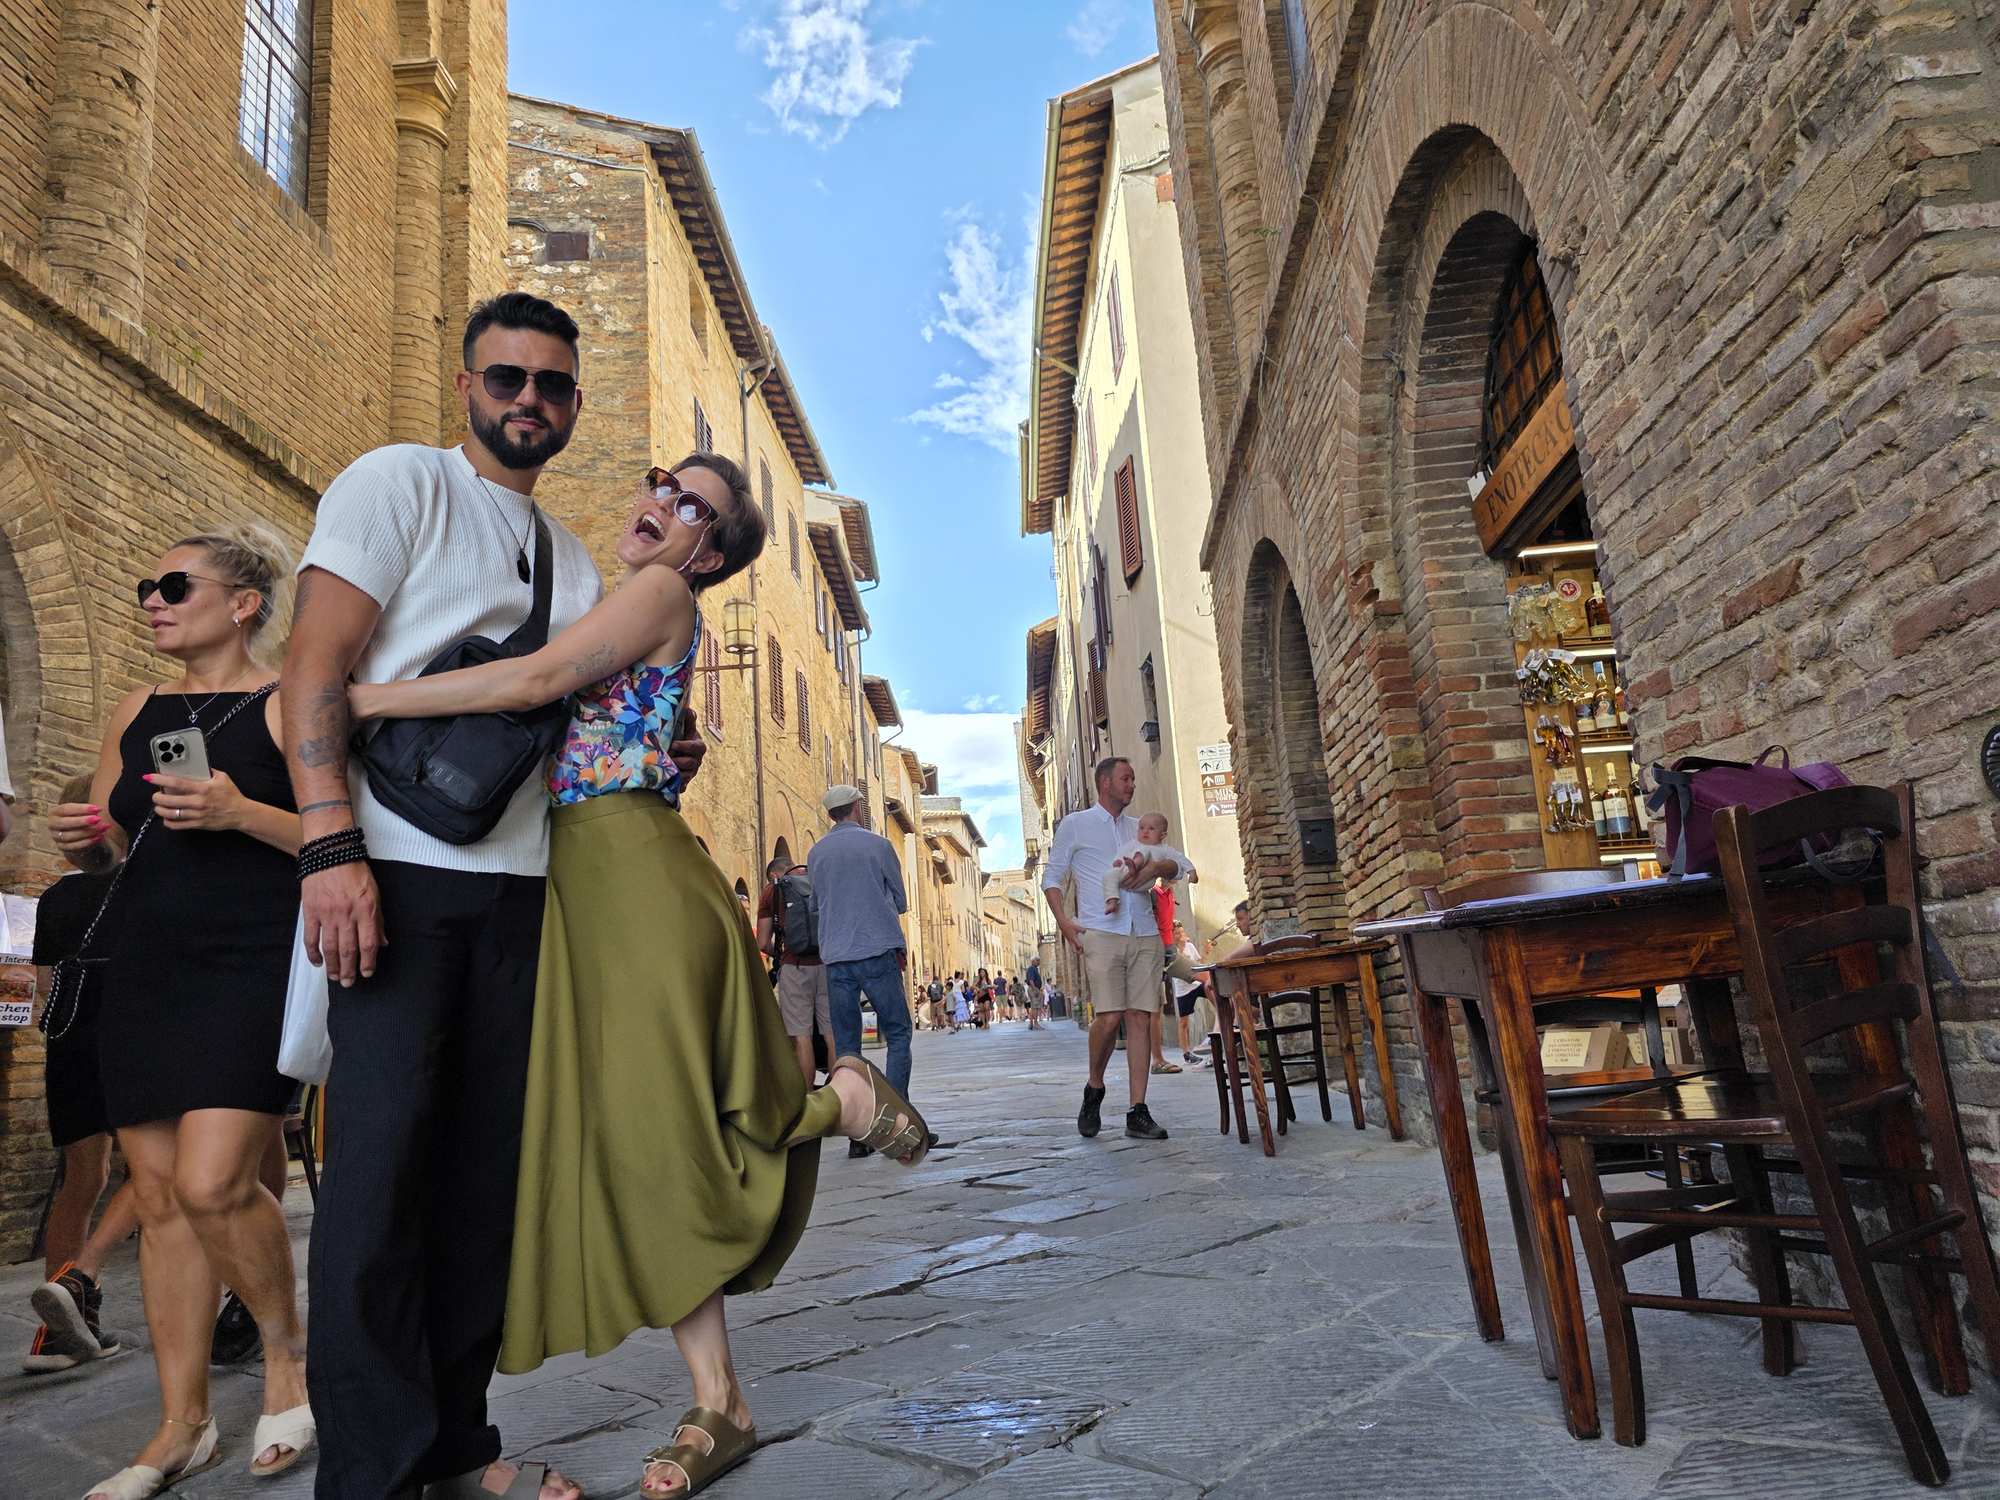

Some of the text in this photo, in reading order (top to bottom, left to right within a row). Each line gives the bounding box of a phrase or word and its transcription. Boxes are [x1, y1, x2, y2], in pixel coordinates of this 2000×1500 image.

[1486, 421, 1558, 523] ENOTECA
[0, 1003, 30, 1013] chen
[1, 1014, 28, 1023] stop
